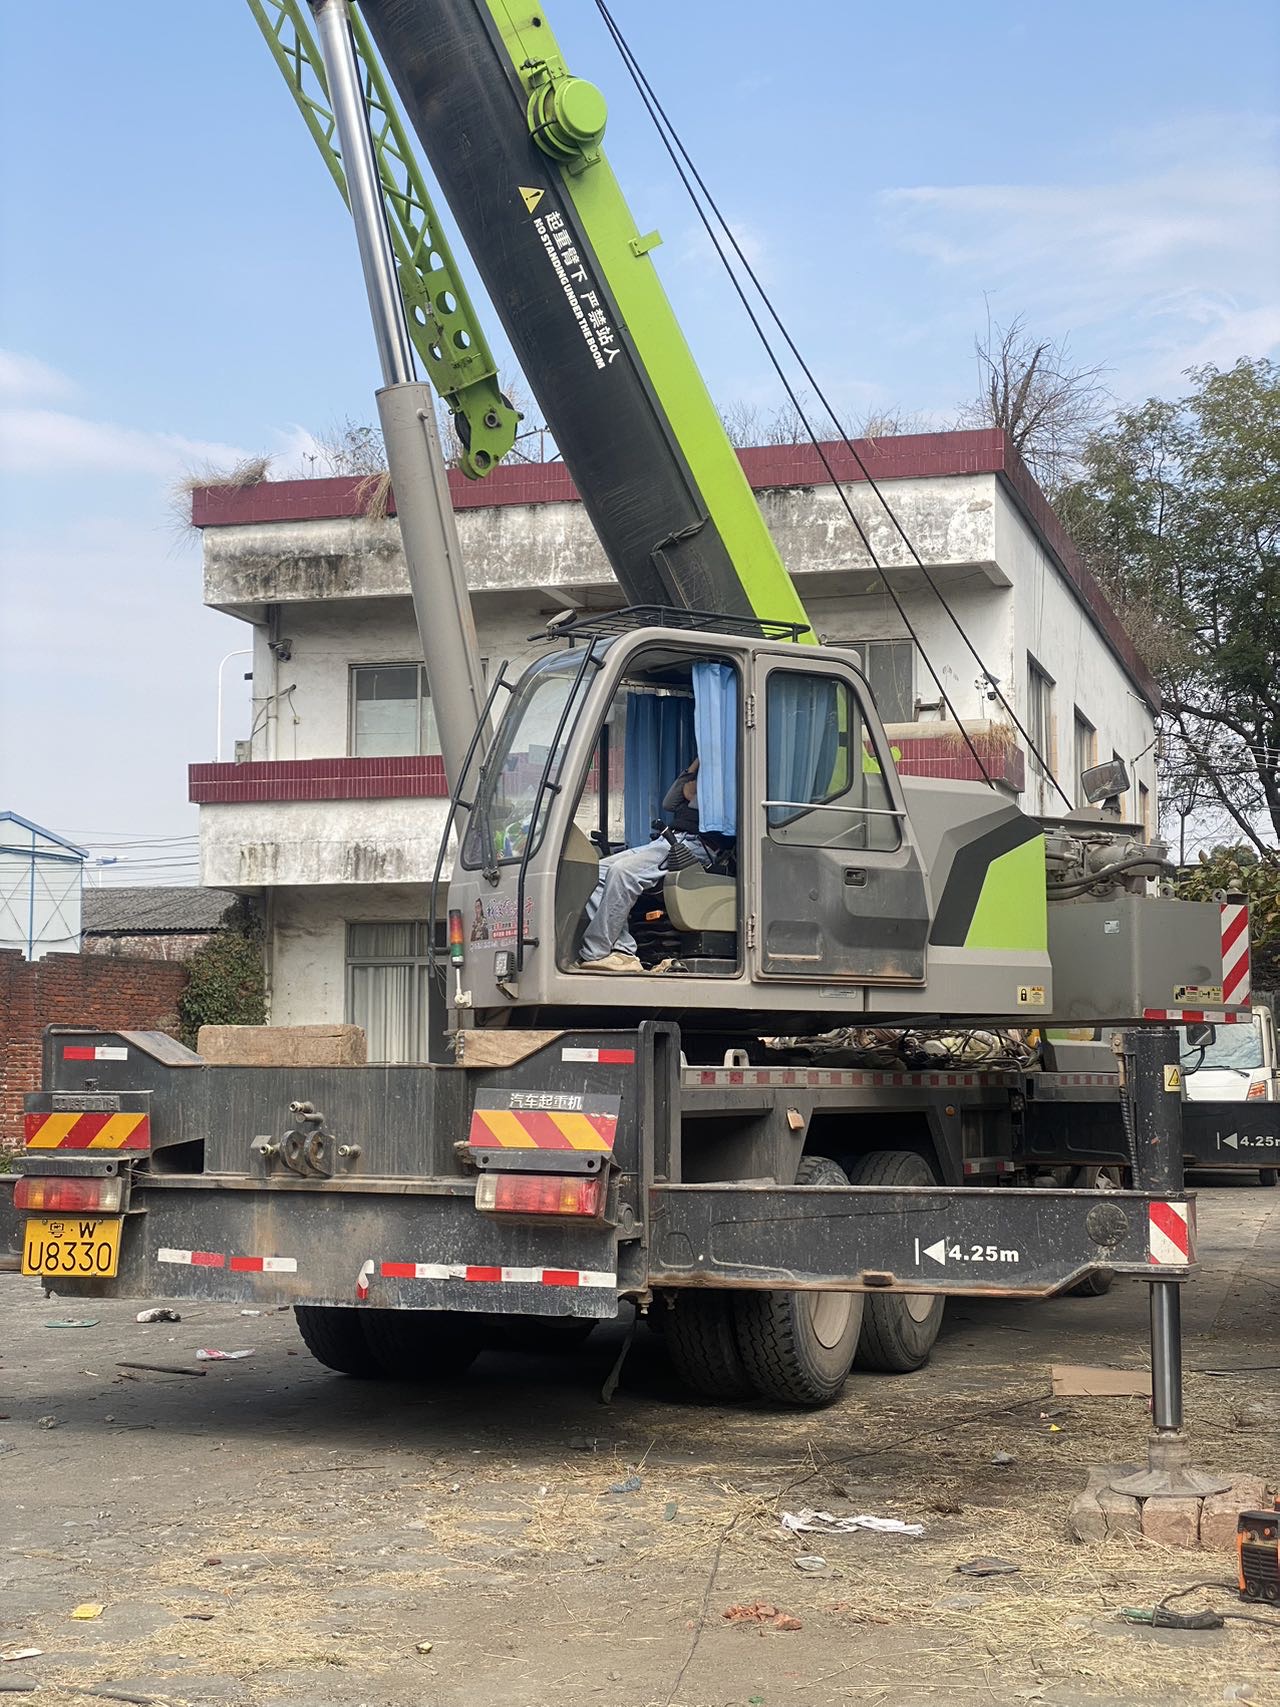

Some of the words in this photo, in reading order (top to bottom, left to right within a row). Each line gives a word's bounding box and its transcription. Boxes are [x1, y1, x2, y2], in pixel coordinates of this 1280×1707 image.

[533, 217, 547, 235] NO
[541, 233, 570, 286] STANDING
[563, 284, 585, 320] UNDER
[578, 318, 594, 339] THE
[586, 337, 606, 370] BOOM
[544, 210, 588, 283] 起重臂下
[580, 289, 621, 364] 严禁站人
[509, 1093, 583, 1111] 汽车起重机
[28, 1241, 112, 1272] U8330
[948, 1244, 1020, 1263] 4.25m
